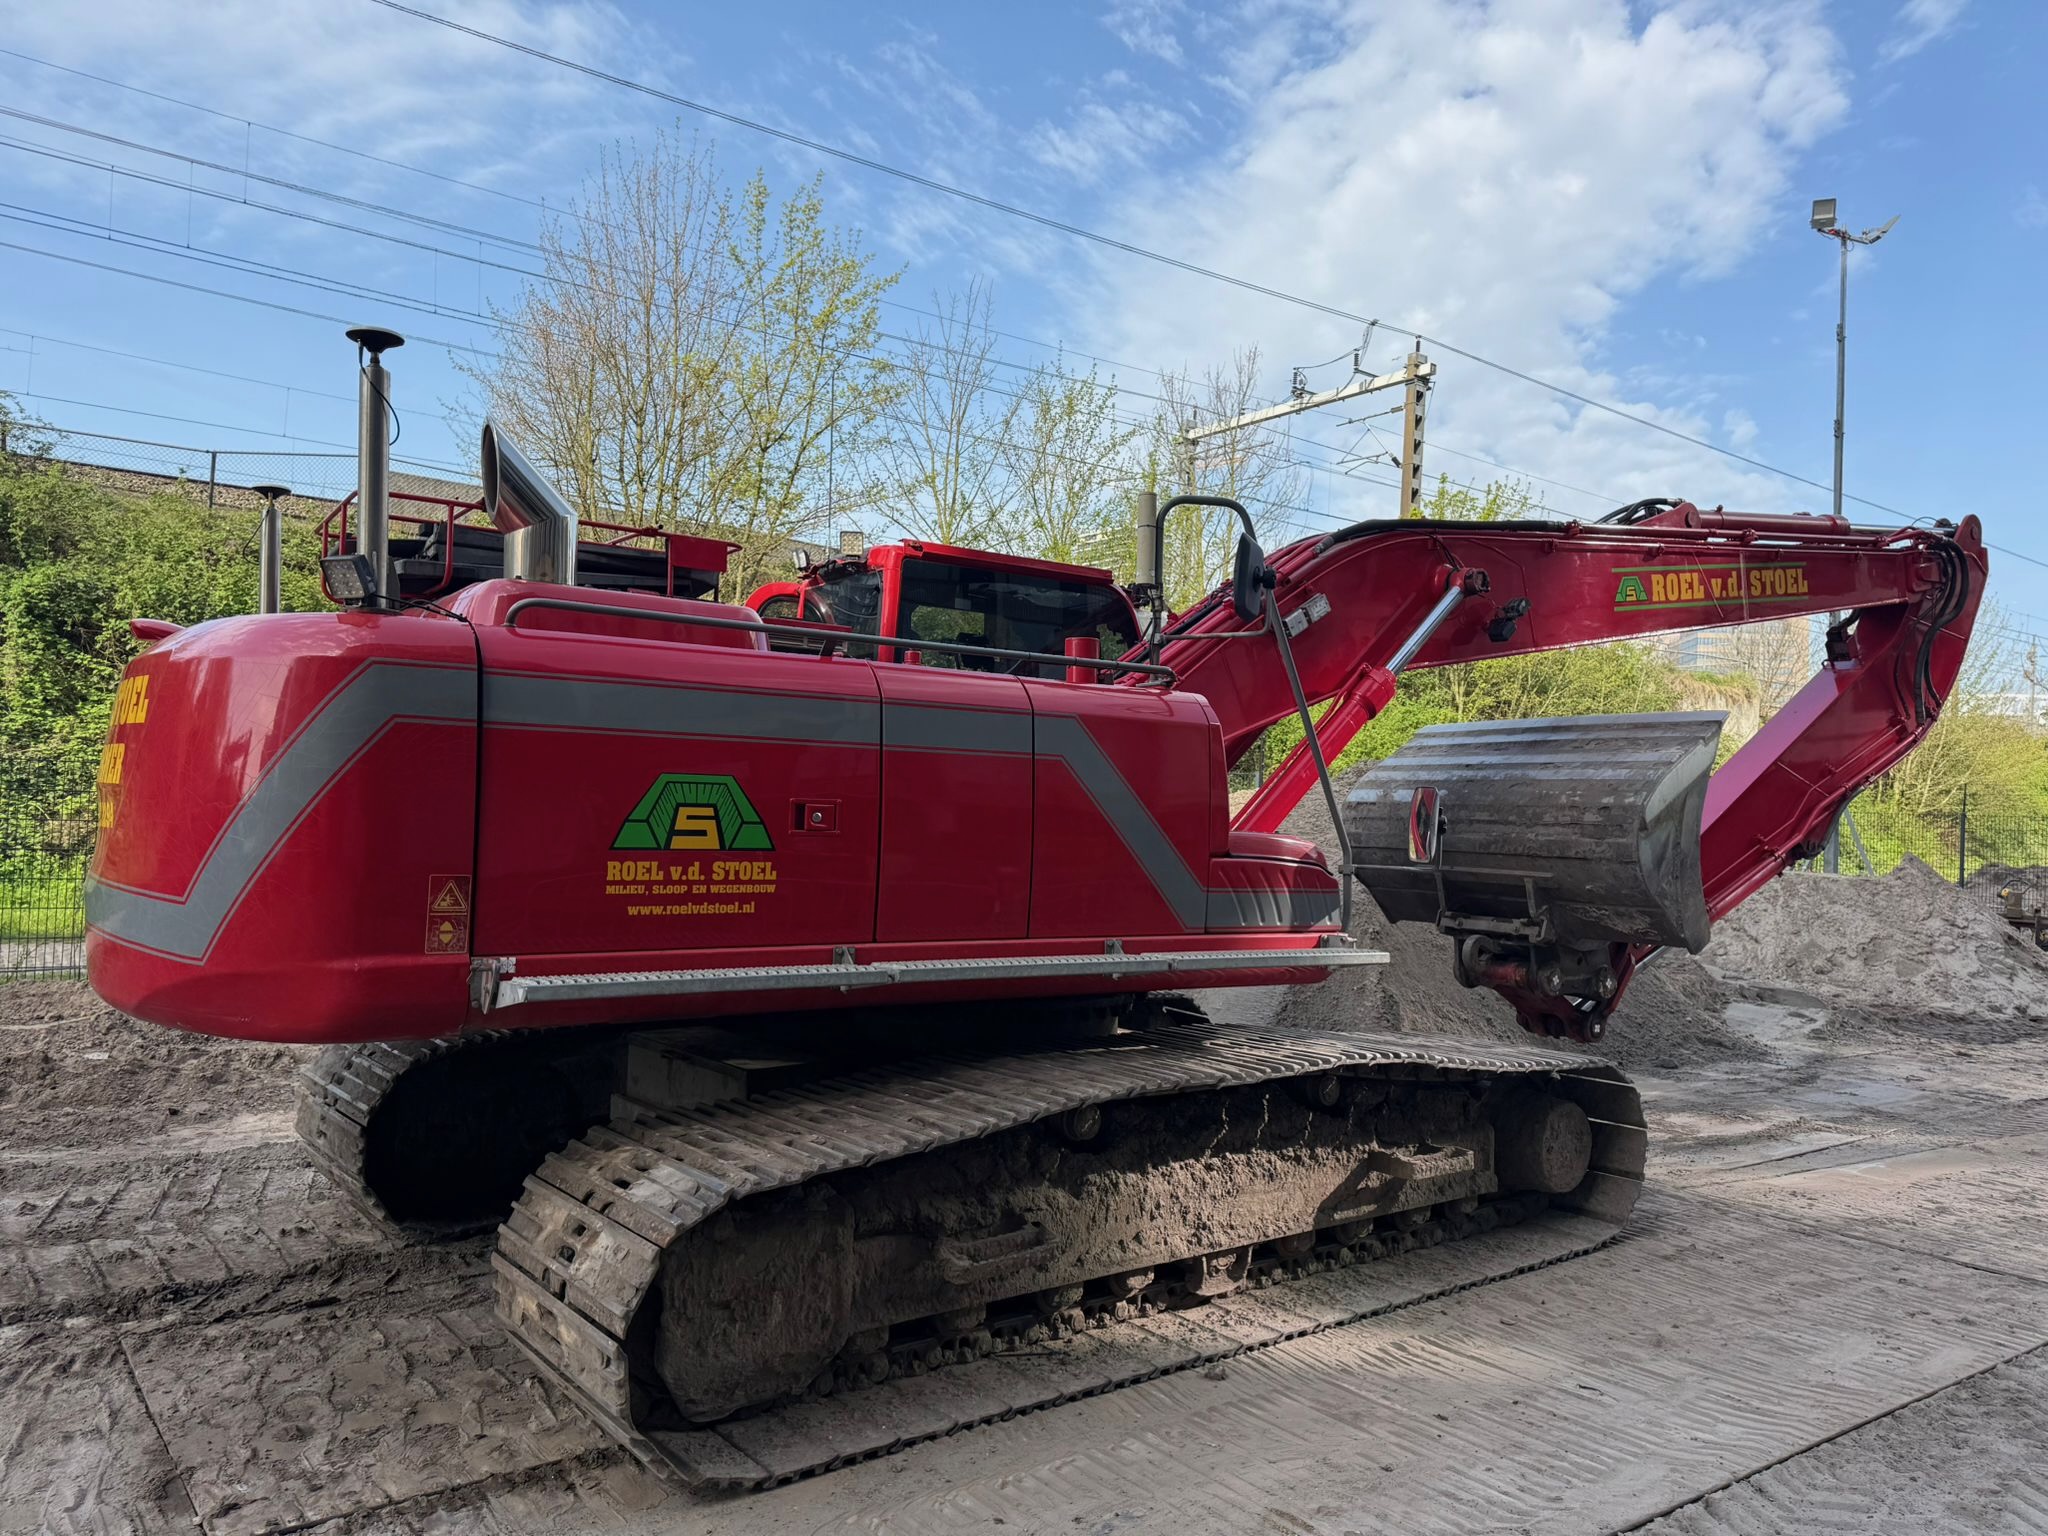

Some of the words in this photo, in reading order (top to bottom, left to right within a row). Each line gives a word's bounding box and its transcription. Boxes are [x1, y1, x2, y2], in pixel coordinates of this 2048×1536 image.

[1651, 571, 1705, 602] ROEL
[1710, 570, 1744, 599] v.d.
[1750, 568, 1808, 597] STOEL
[110, 674, 150, 726] TOEL
[670, 806, 721, 850] S
[606, 861, 664, 881] ROEL
[670, 861, 706, 881] v.d.
[712, 861, 777, 881] STOEL
[605, 885, 649, 896] MILIEU,
[652, 885, 688, 895] SLOOP
[692, 884, 707, 894] EN
[710, 884, 776, 894] WEGENBOUW
[627, 901, 756, 916] www.roelvdstoel.nl
